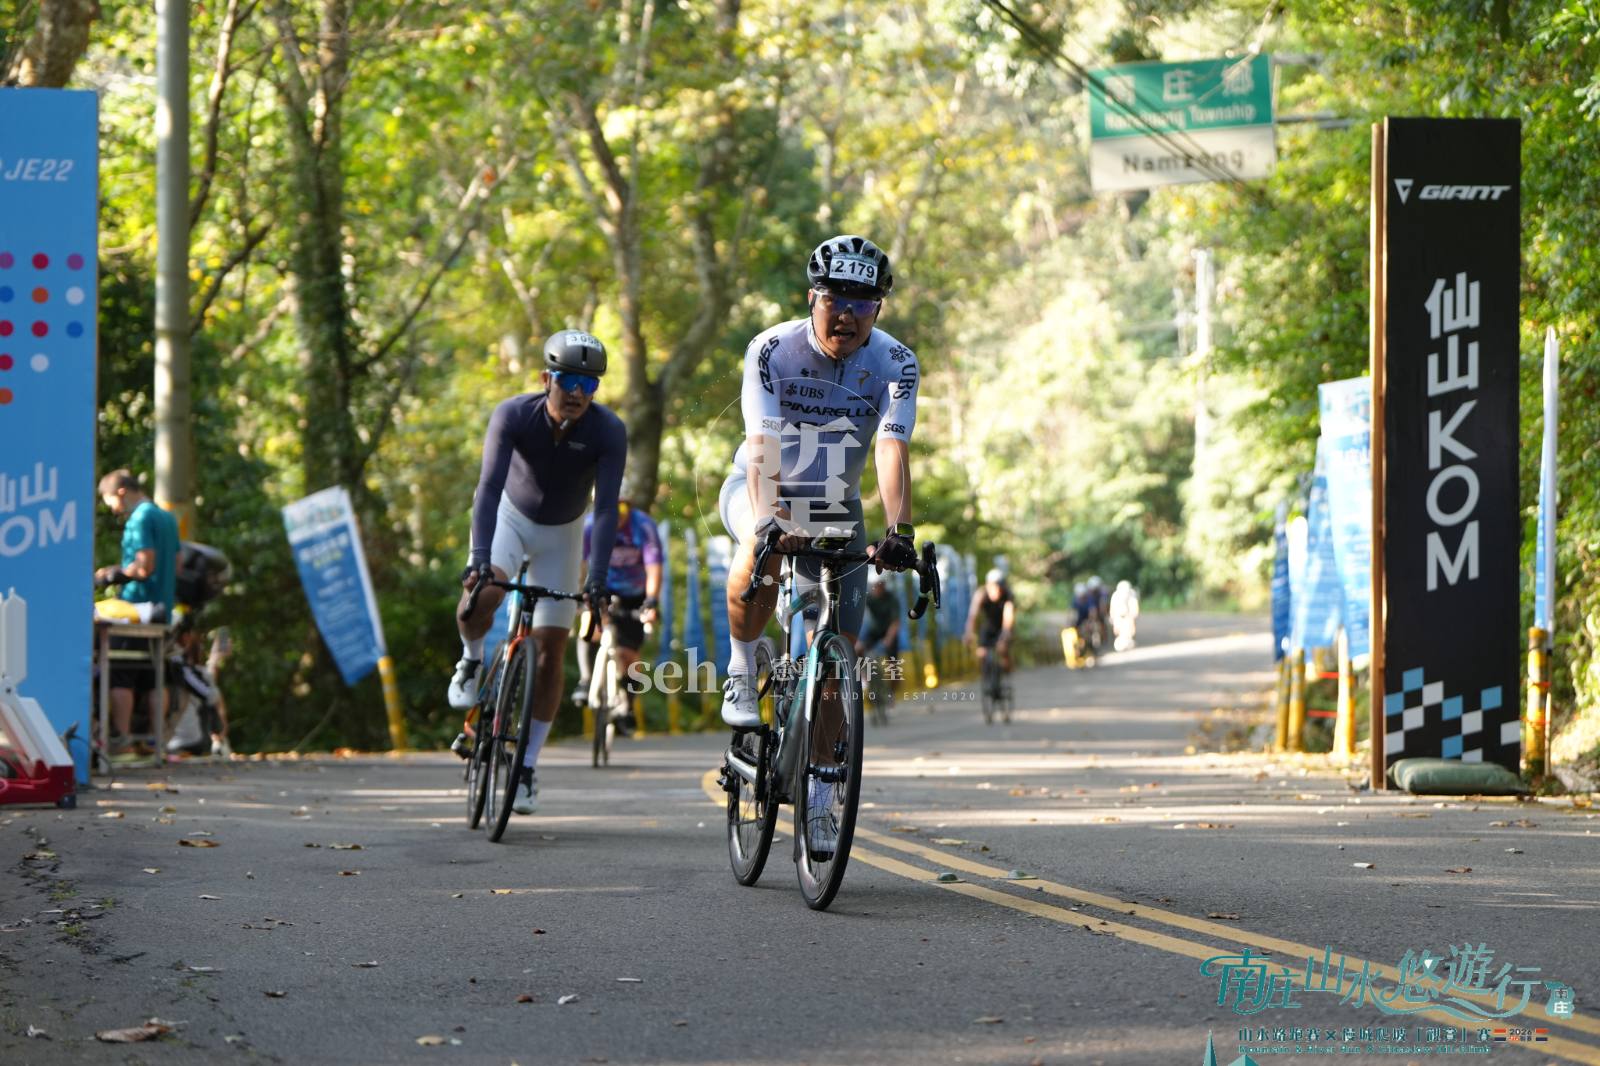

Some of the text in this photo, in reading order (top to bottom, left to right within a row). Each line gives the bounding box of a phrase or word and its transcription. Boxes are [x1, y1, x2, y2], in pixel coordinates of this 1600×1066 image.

[0, 158, 74, 181] JE22
[1418, 184, 1512, 201] GIANT
[834, 260, 875, 279] 2179
[893, 362, 917, 401] UBS
[800, 386, 825, 400] UBS
[780, 400, 880, 418] PINARELLO
[884, 422, 906, 435] SGS
[1424, 271, 1480, 592] 仙山 KOM
